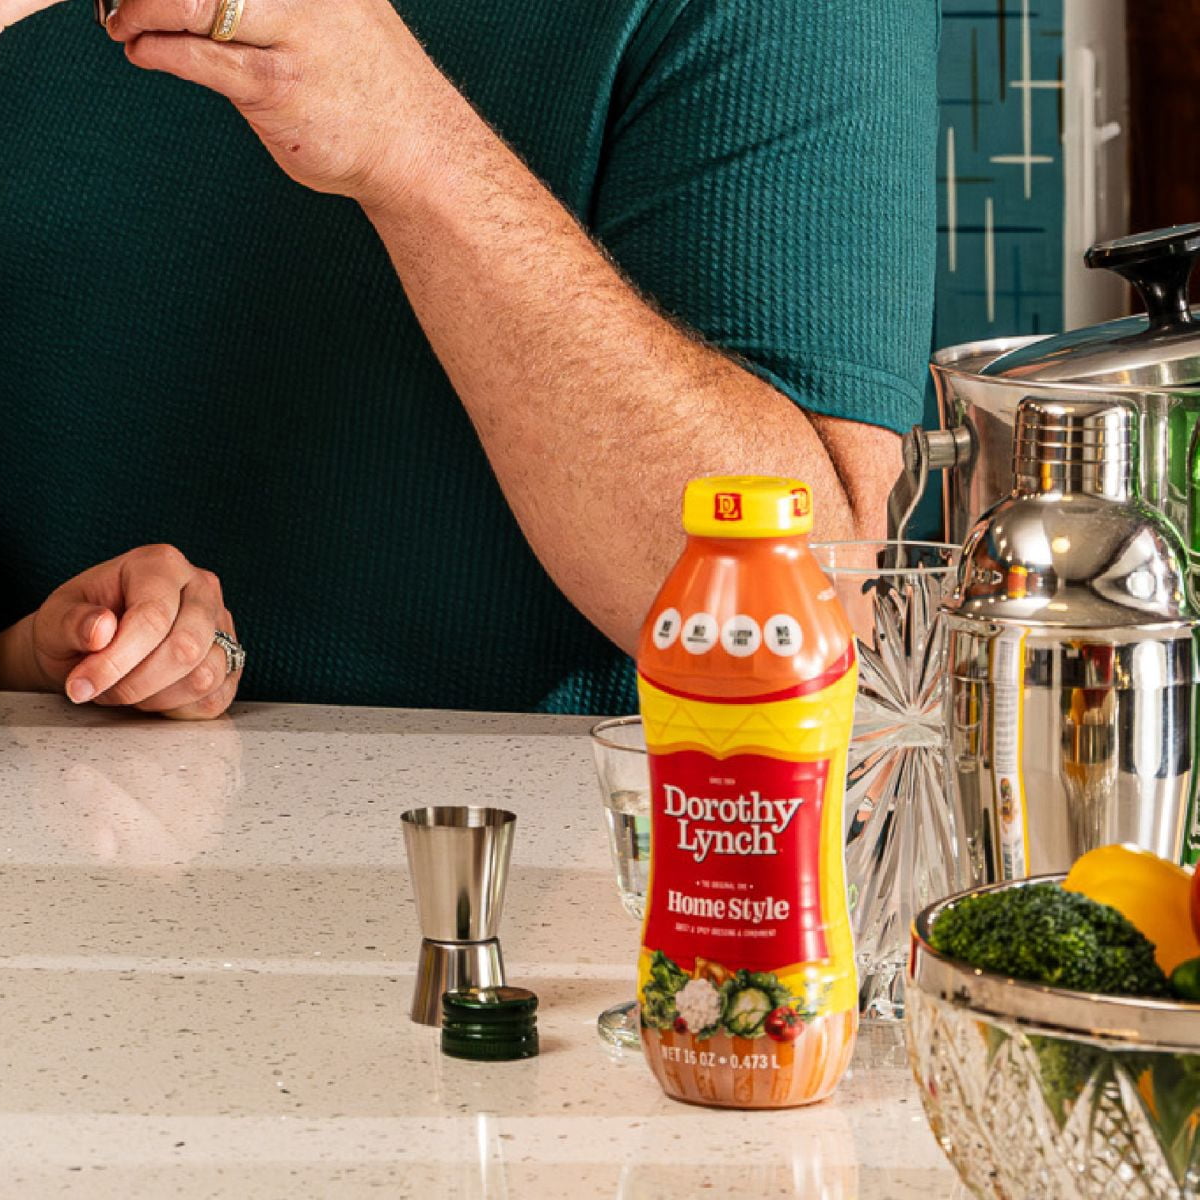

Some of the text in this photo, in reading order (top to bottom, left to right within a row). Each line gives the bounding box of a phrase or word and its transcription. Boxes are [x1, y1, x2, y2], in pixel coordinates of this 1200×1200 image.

[663, 784, 803, 833] Dorothy
[677, 818, 778, 863] Lynch
[668, 889, 790, 924] Home Style
[661, 1045, 781, 1069] NET 16 OZ 0.473 L
